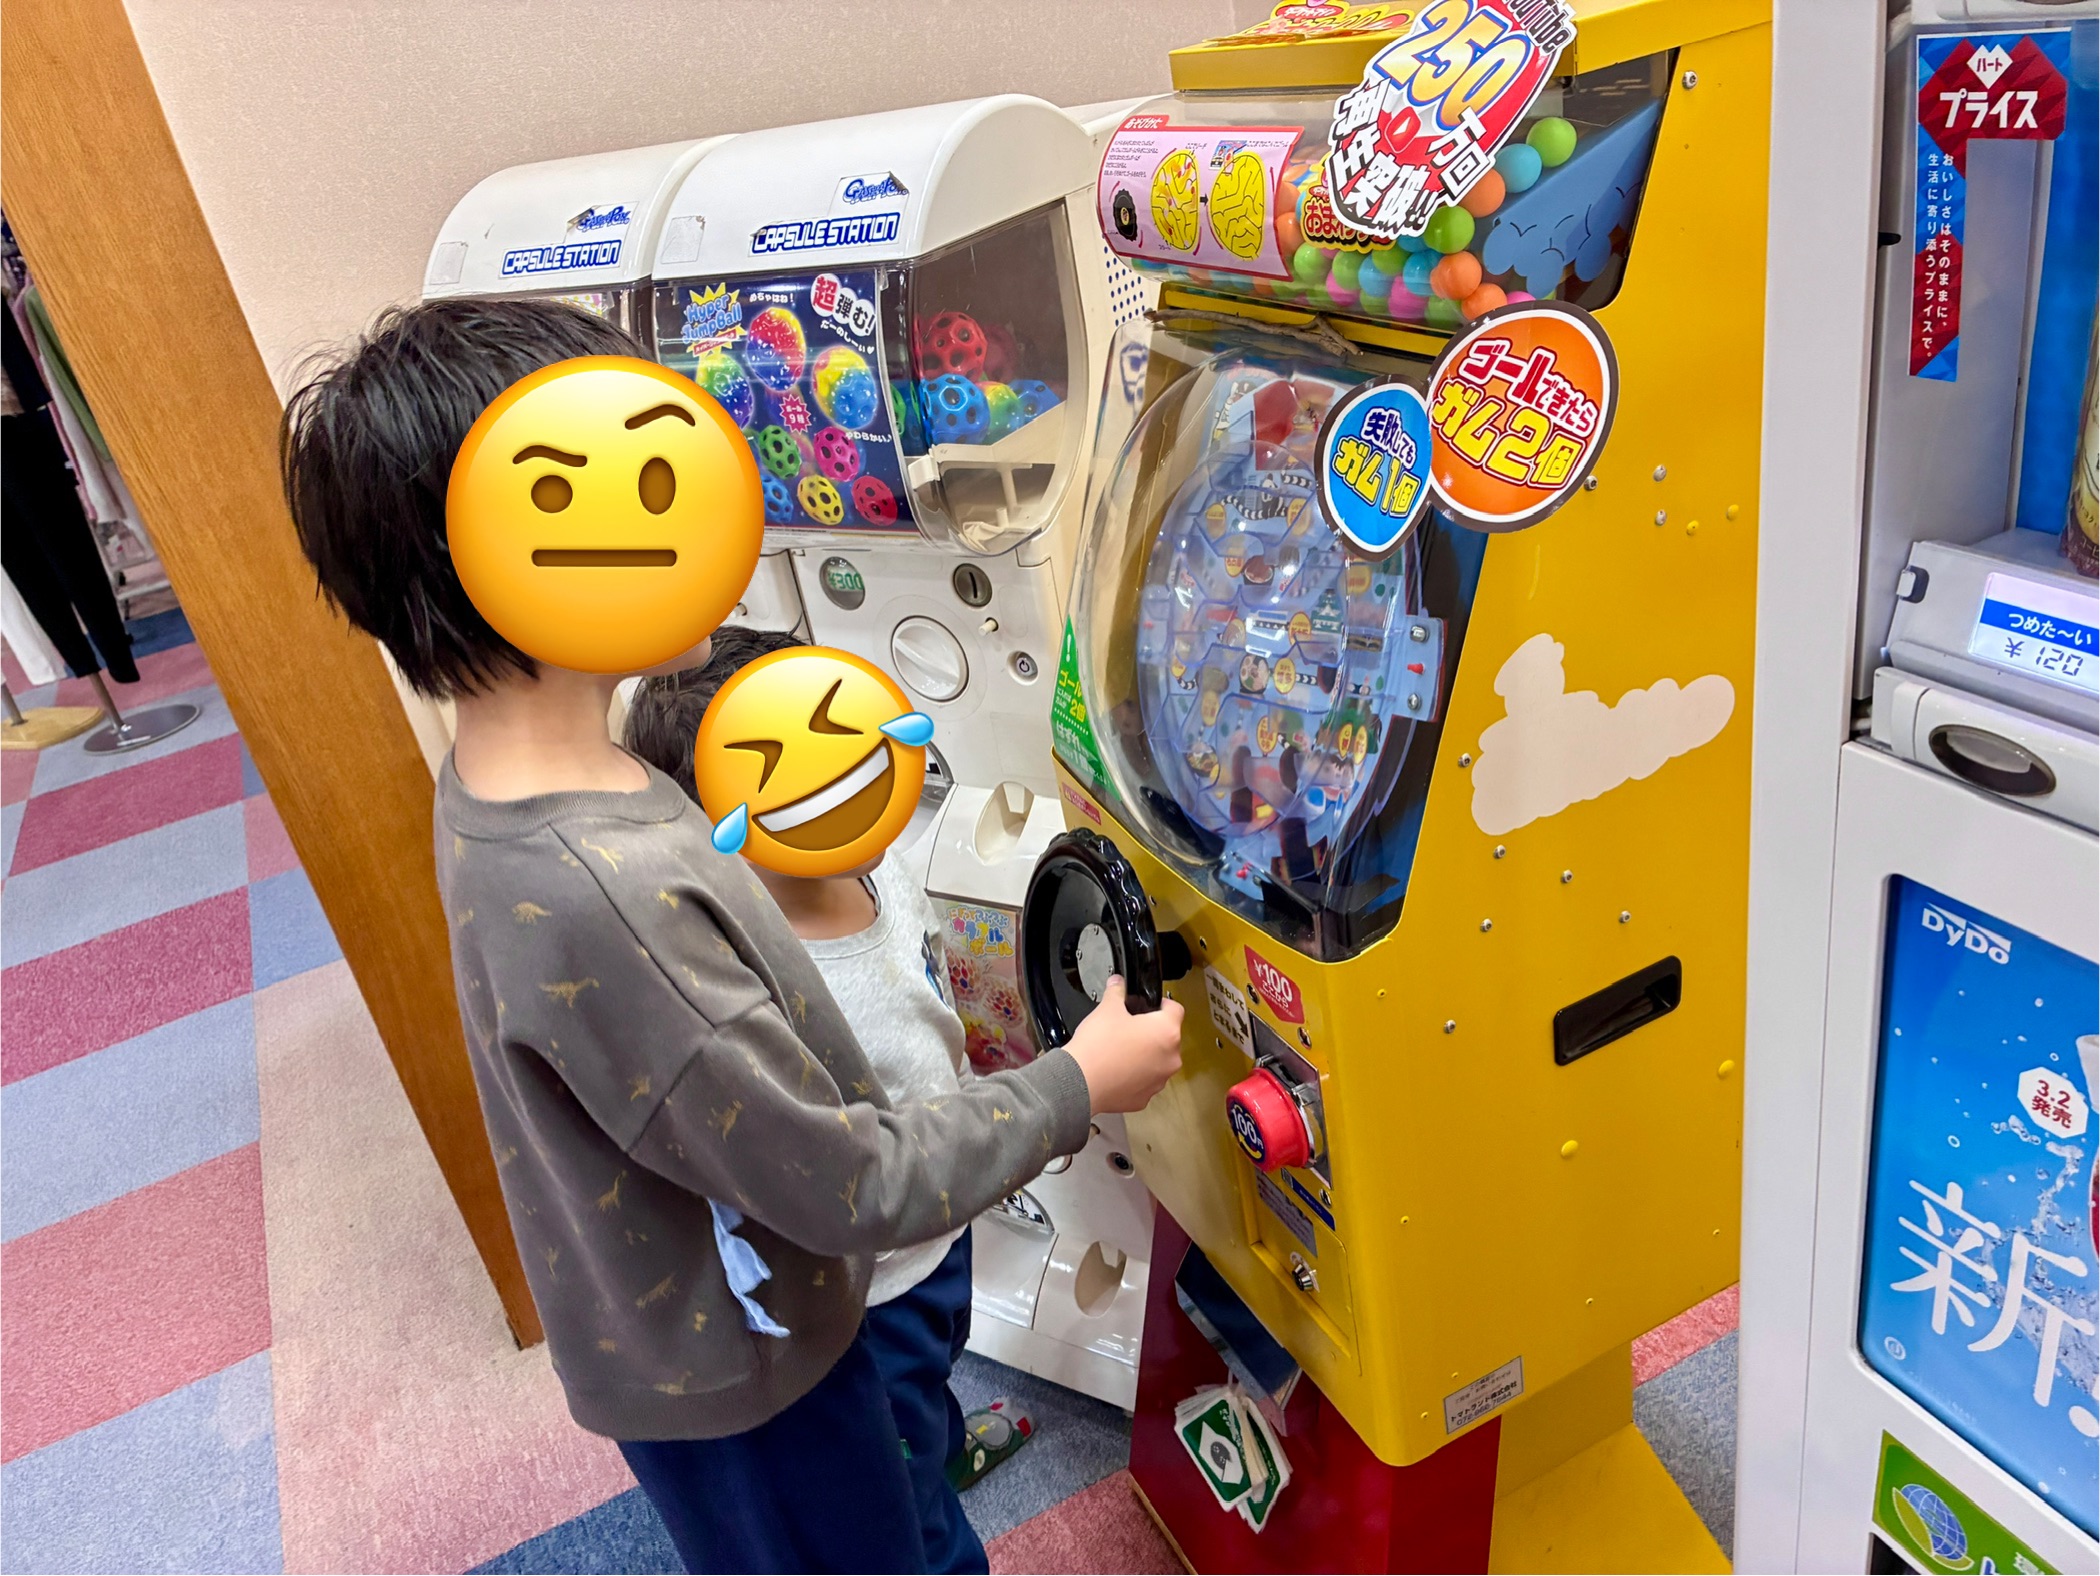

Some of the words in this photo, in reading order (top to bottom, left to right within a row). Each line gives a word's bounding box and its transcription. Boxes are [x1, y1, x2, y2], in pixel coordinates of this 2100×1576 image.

[1499, 0, 1569, 54] uTube
[1976, 58, 2003, 73] ハート
[1939, 88, 2039, 129] プライス
[1921, 152, 1940, 358] 生活に寄り添うプライスで。
[1936, 152, 1955, 328] おいしさはそのままに、
[685, 293, 730, 324] Hyper
[1364, 410, 1416, 465] 失敗しても
[1431, 381, 1584, 485] ガム2個
[1334, 438, 1420, 516] ガム1個
[828, 572, 865, 590] ¥300
[2035, 646, 2085, 677] 120
[1921, 901, 2012, 966] DyDo
[1253, 959, 1294, 1004] ¥100
[2031, 1096, 2073, 1130] 発売
[2036, 1079, 2072, 1109] 3.2
[1890, 1179, 2098, 1438] 新
